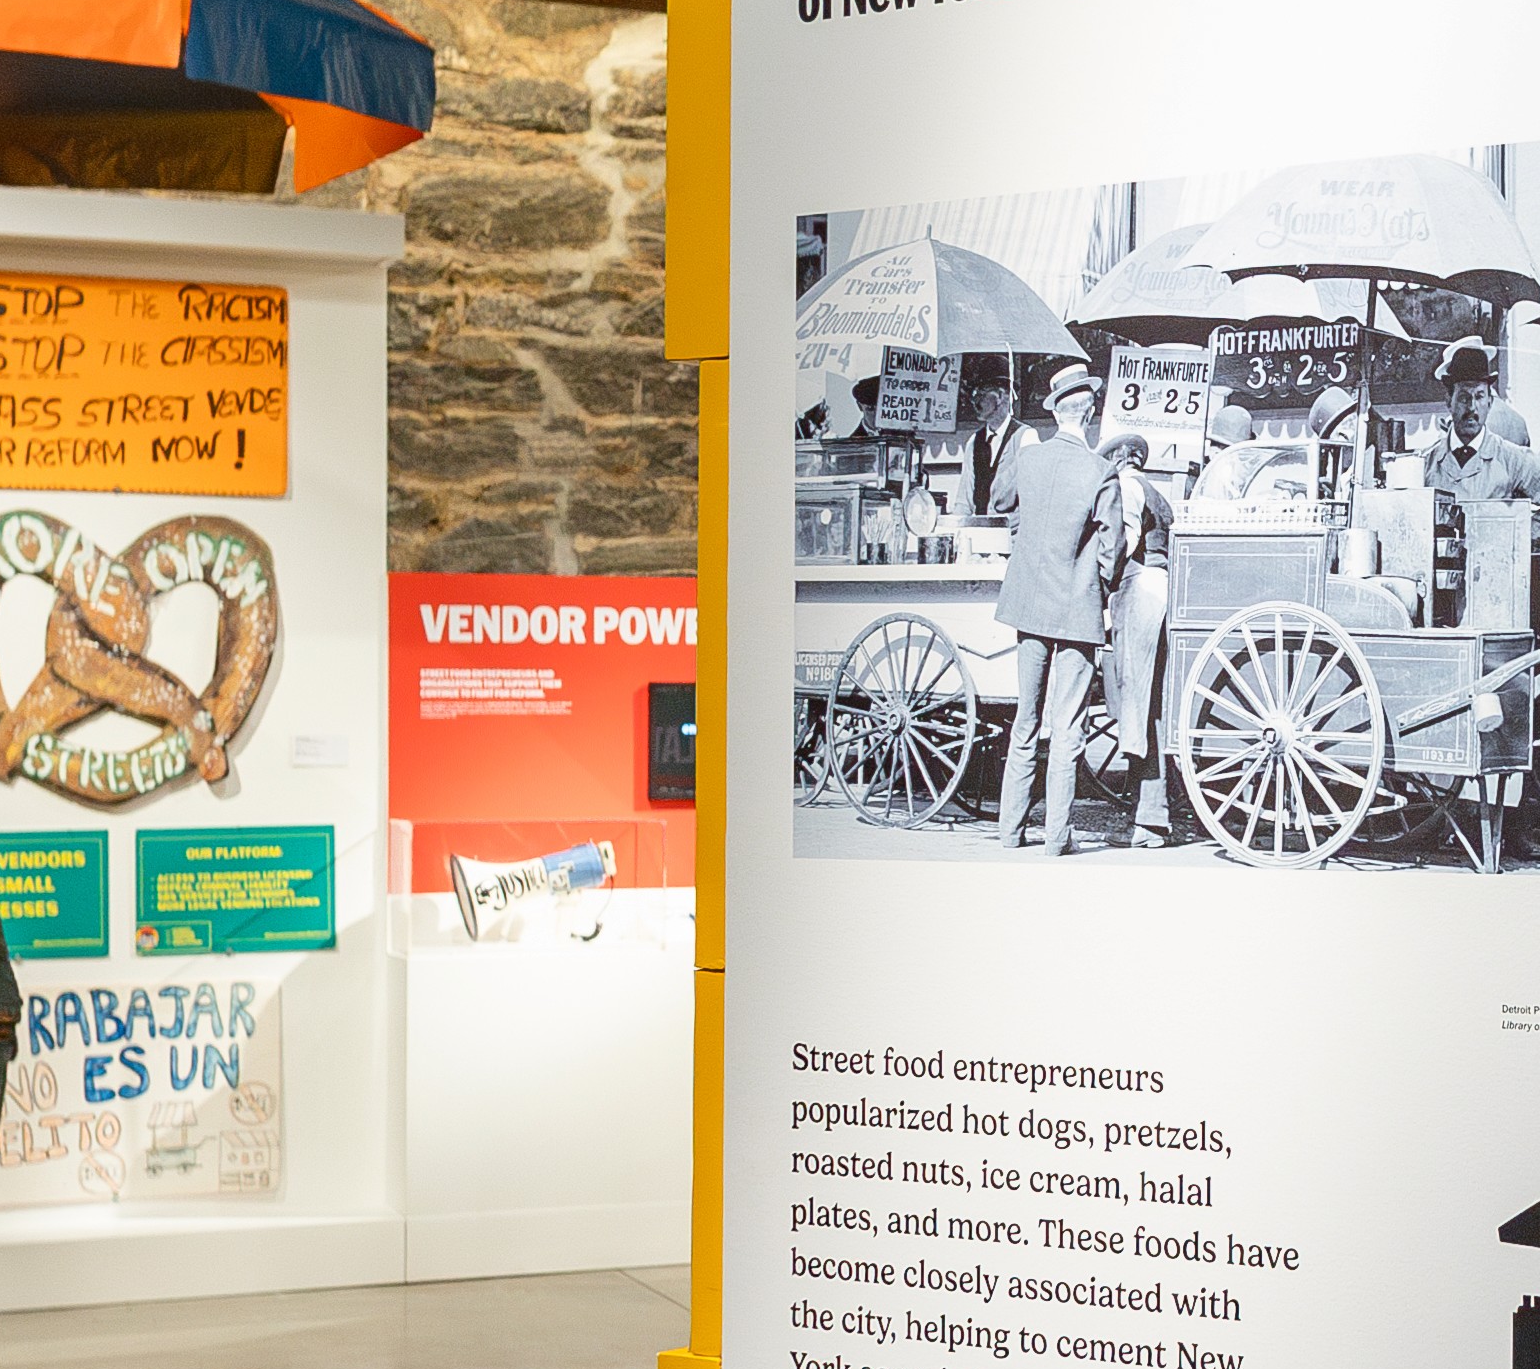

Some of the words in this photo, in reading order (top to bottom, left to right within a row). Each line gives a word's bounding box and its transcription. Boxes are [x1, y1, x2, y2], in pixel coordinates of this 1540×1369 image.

[870, 266, 913, 278] Cars
[887, 256, 912, 266] All
[844, 279, 925, 296] Transfer
[108, 288, 159, 320] THE
[178, 283, 286, 324] RACISM
[101, 340, 150, 369] THE
[883, 345, 937, 375] LEMONADE
[1142, 357, 1208, 382] FRANKFURTE
[77, 393, 195, 427] STREET
[881, 409, 919, 422] MADE
[882, 395, 921, 408] READY
[25, 436, 126, 467] REFORM
[143, 531, 268, 608] OPEN
[419, 604, 587, 644] VENDOR
[593, 607, 697, 645] POWE
[22, 733, 190, 794] STREETS
[27, 982, 256, 1055] RABAJAR
[1501, 1003, 1532, 1015] Detroit
[1501, 1019, 1533, 1033] Library
[84, 1045, 151, 1102] ES
[170, 1044, 239, 1091] UN
[792, 1042, 875, 1075] Street
[883, 1046, 945, 1080] food
[953, 1057, 1164, 1094] entrepreneurs
